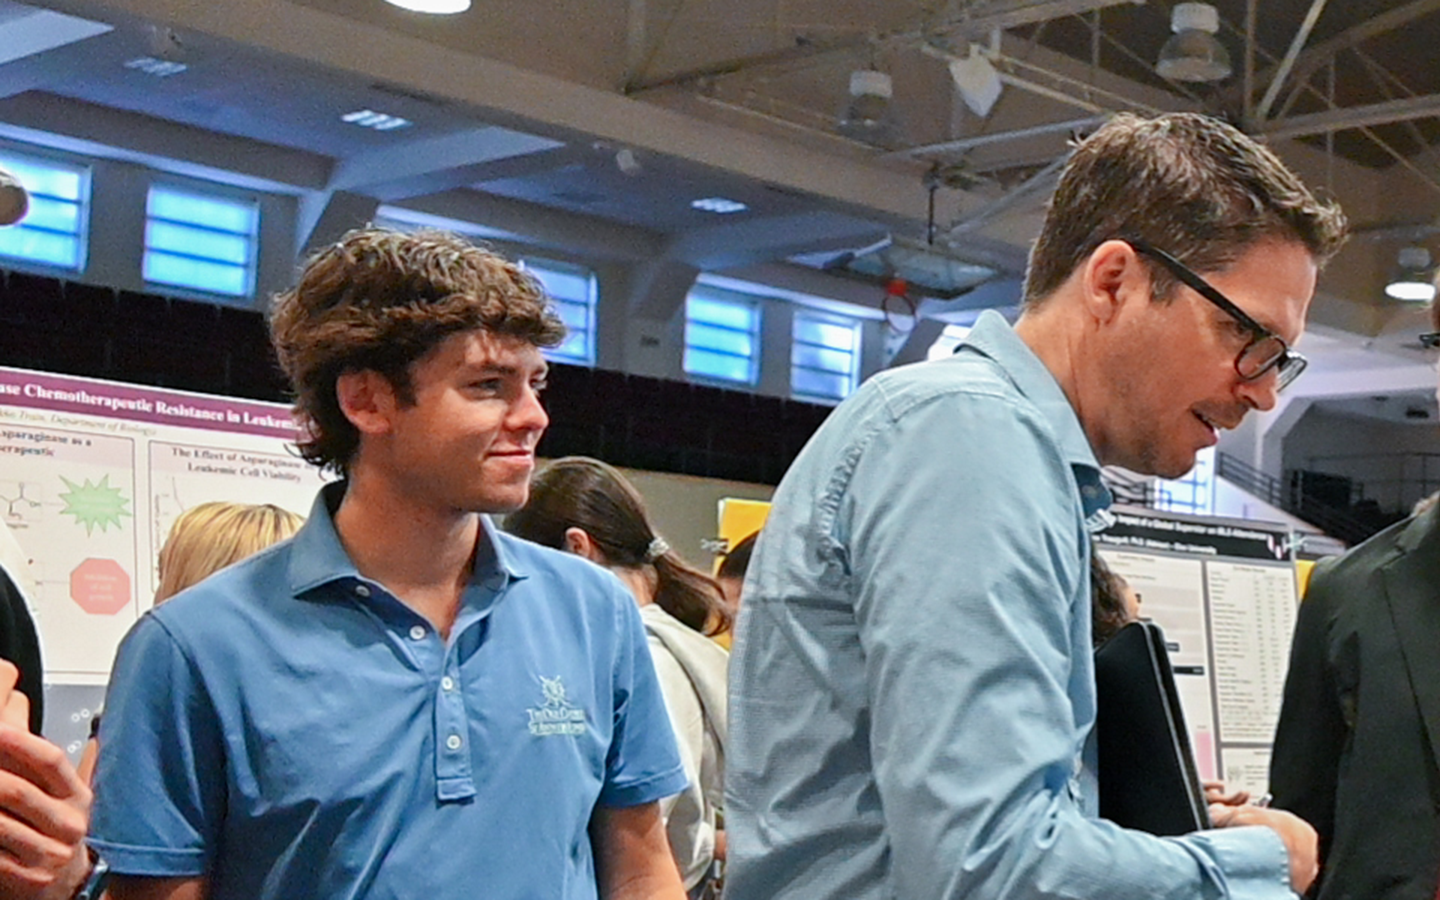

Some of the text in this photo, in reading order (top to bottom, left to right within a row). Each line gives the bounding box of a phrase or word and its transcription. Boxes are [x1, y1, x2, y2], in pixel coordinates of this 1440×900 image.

[24, 383, 153, 413] Chemotherapeutic
[156, 401, 224, 422] Resistance
[227, 410, 240, 423] in
[244, 412, 302, 431] Leukemi
